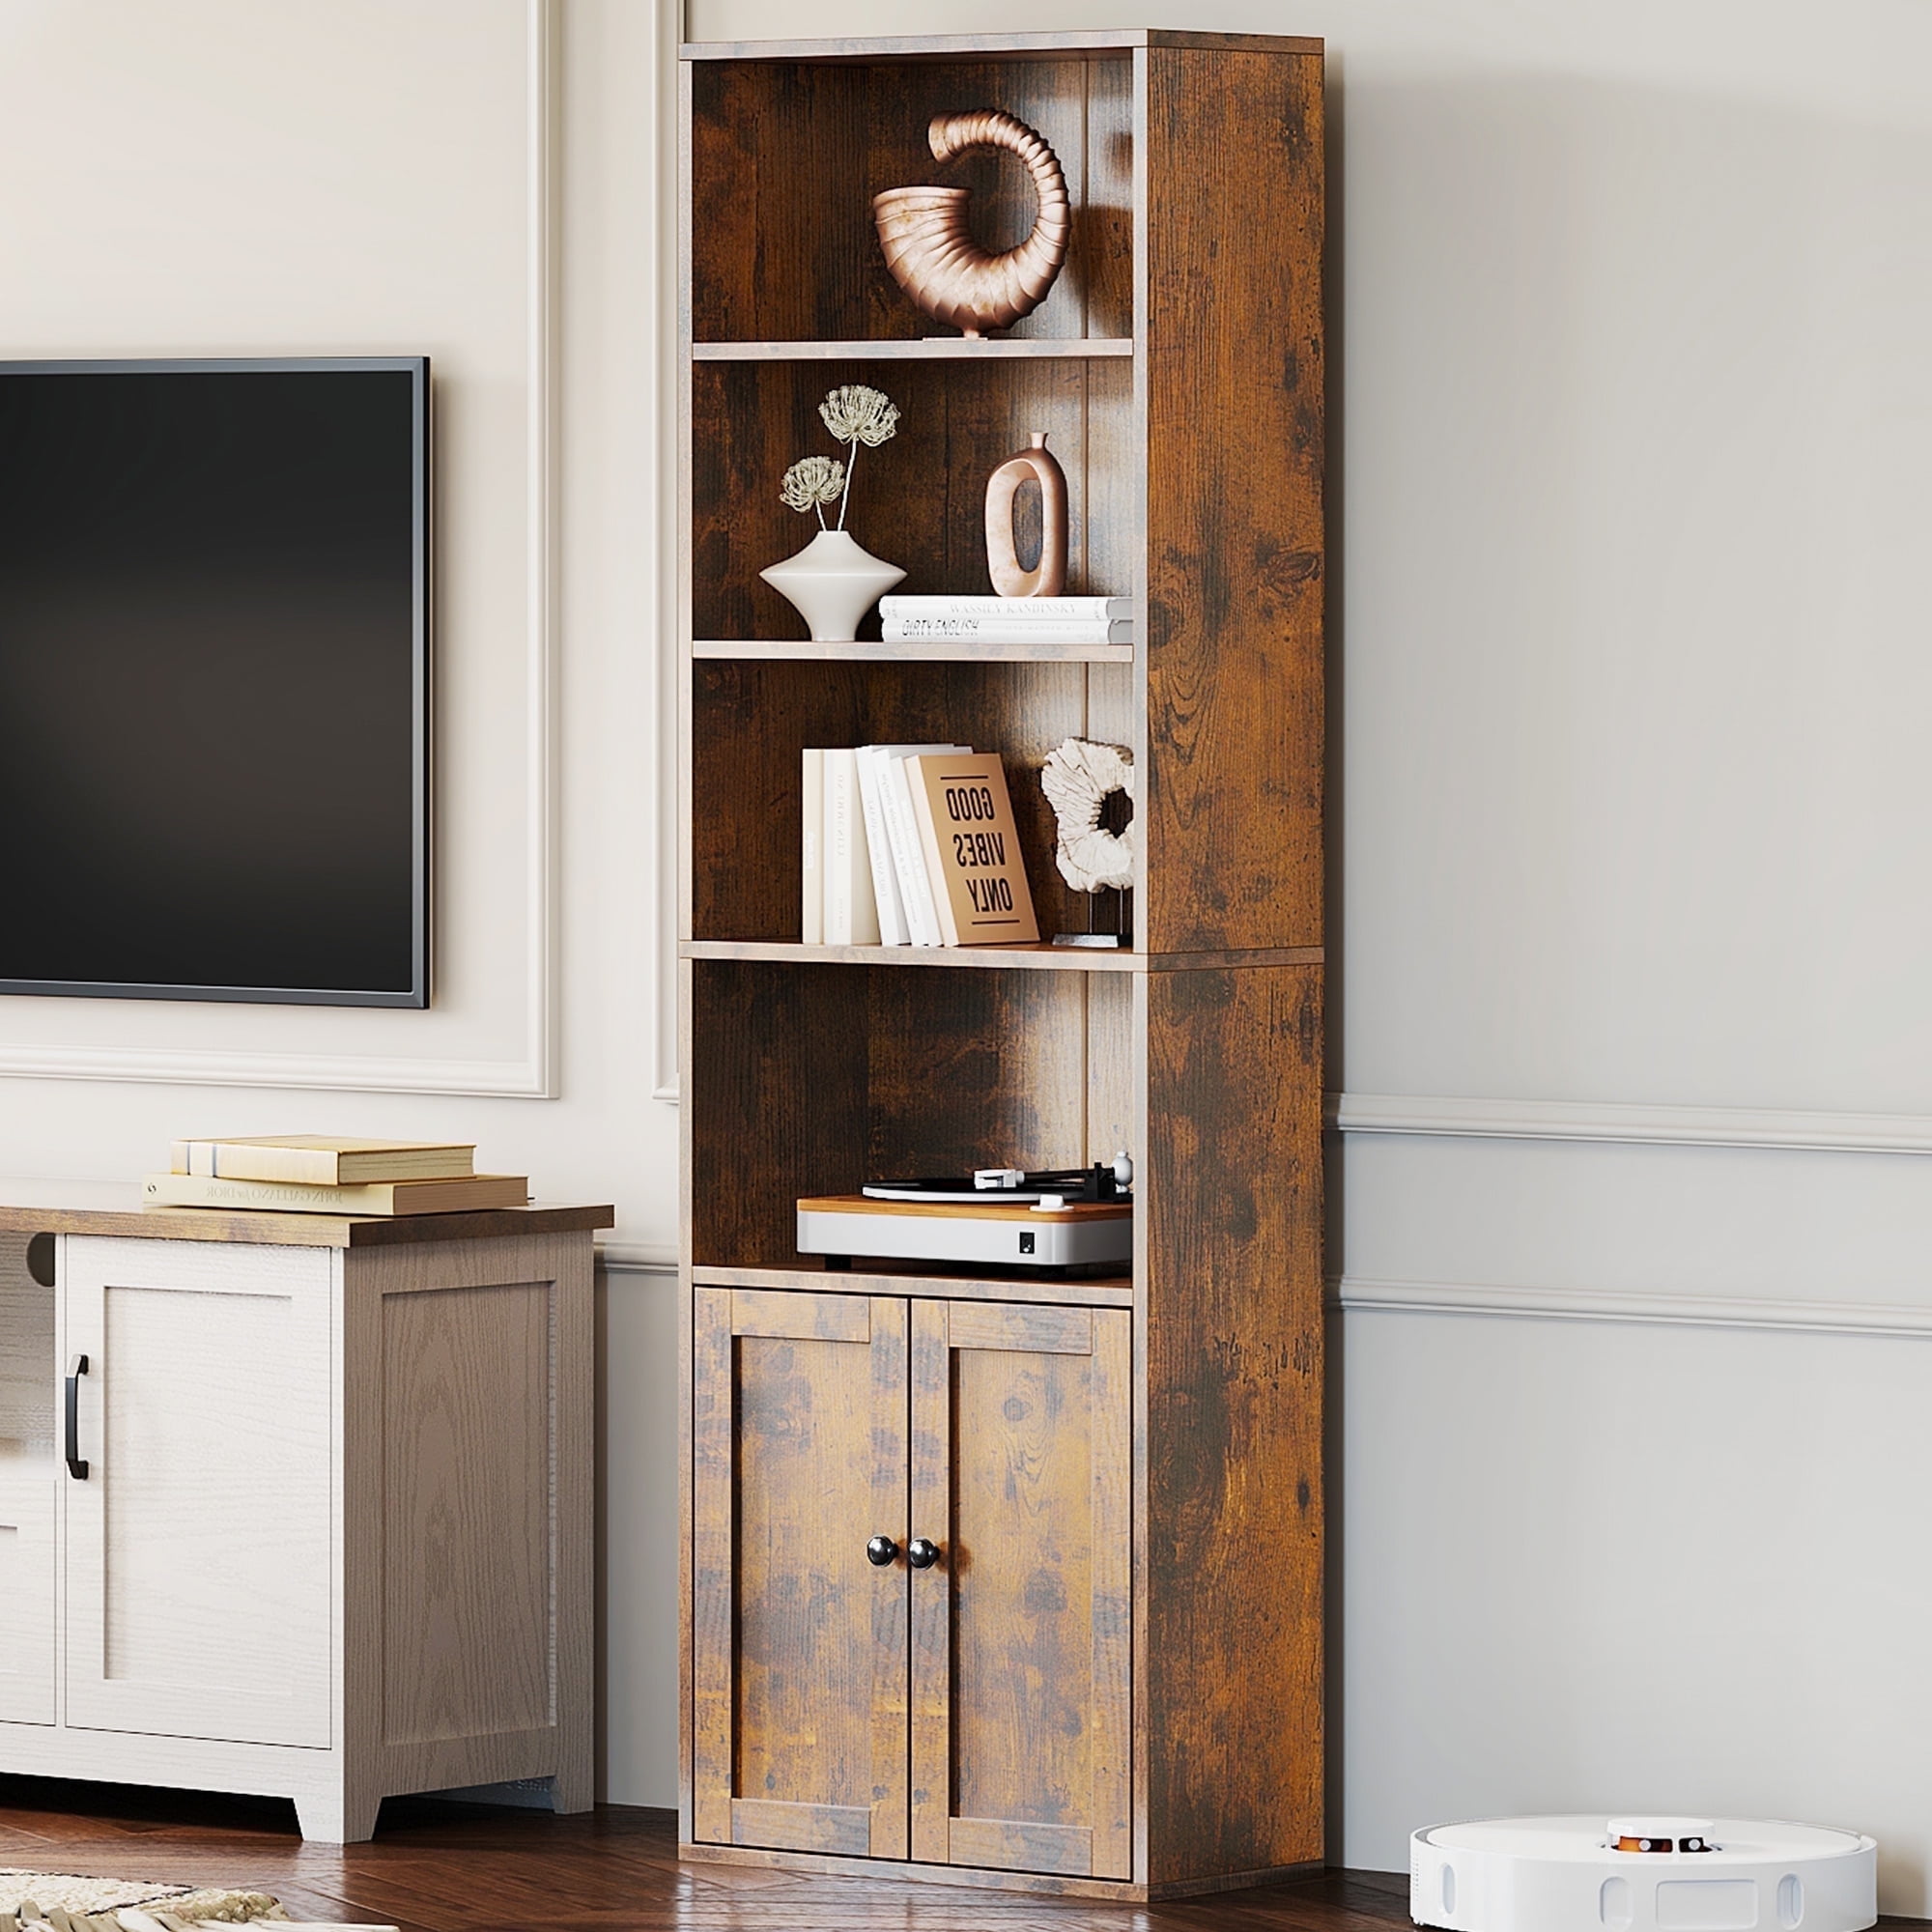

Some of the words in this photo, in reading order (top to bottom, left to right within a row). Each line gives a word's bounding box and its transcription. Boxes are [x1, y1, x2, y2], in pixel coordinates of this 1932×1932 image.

[950, 603, 1001, 614] WASSILY
[1007, 603, 1075, 614] KANDINSKY
[901, 619, 934, 637] DIRTY
[934, 619, 980, 637] ENGLISH
